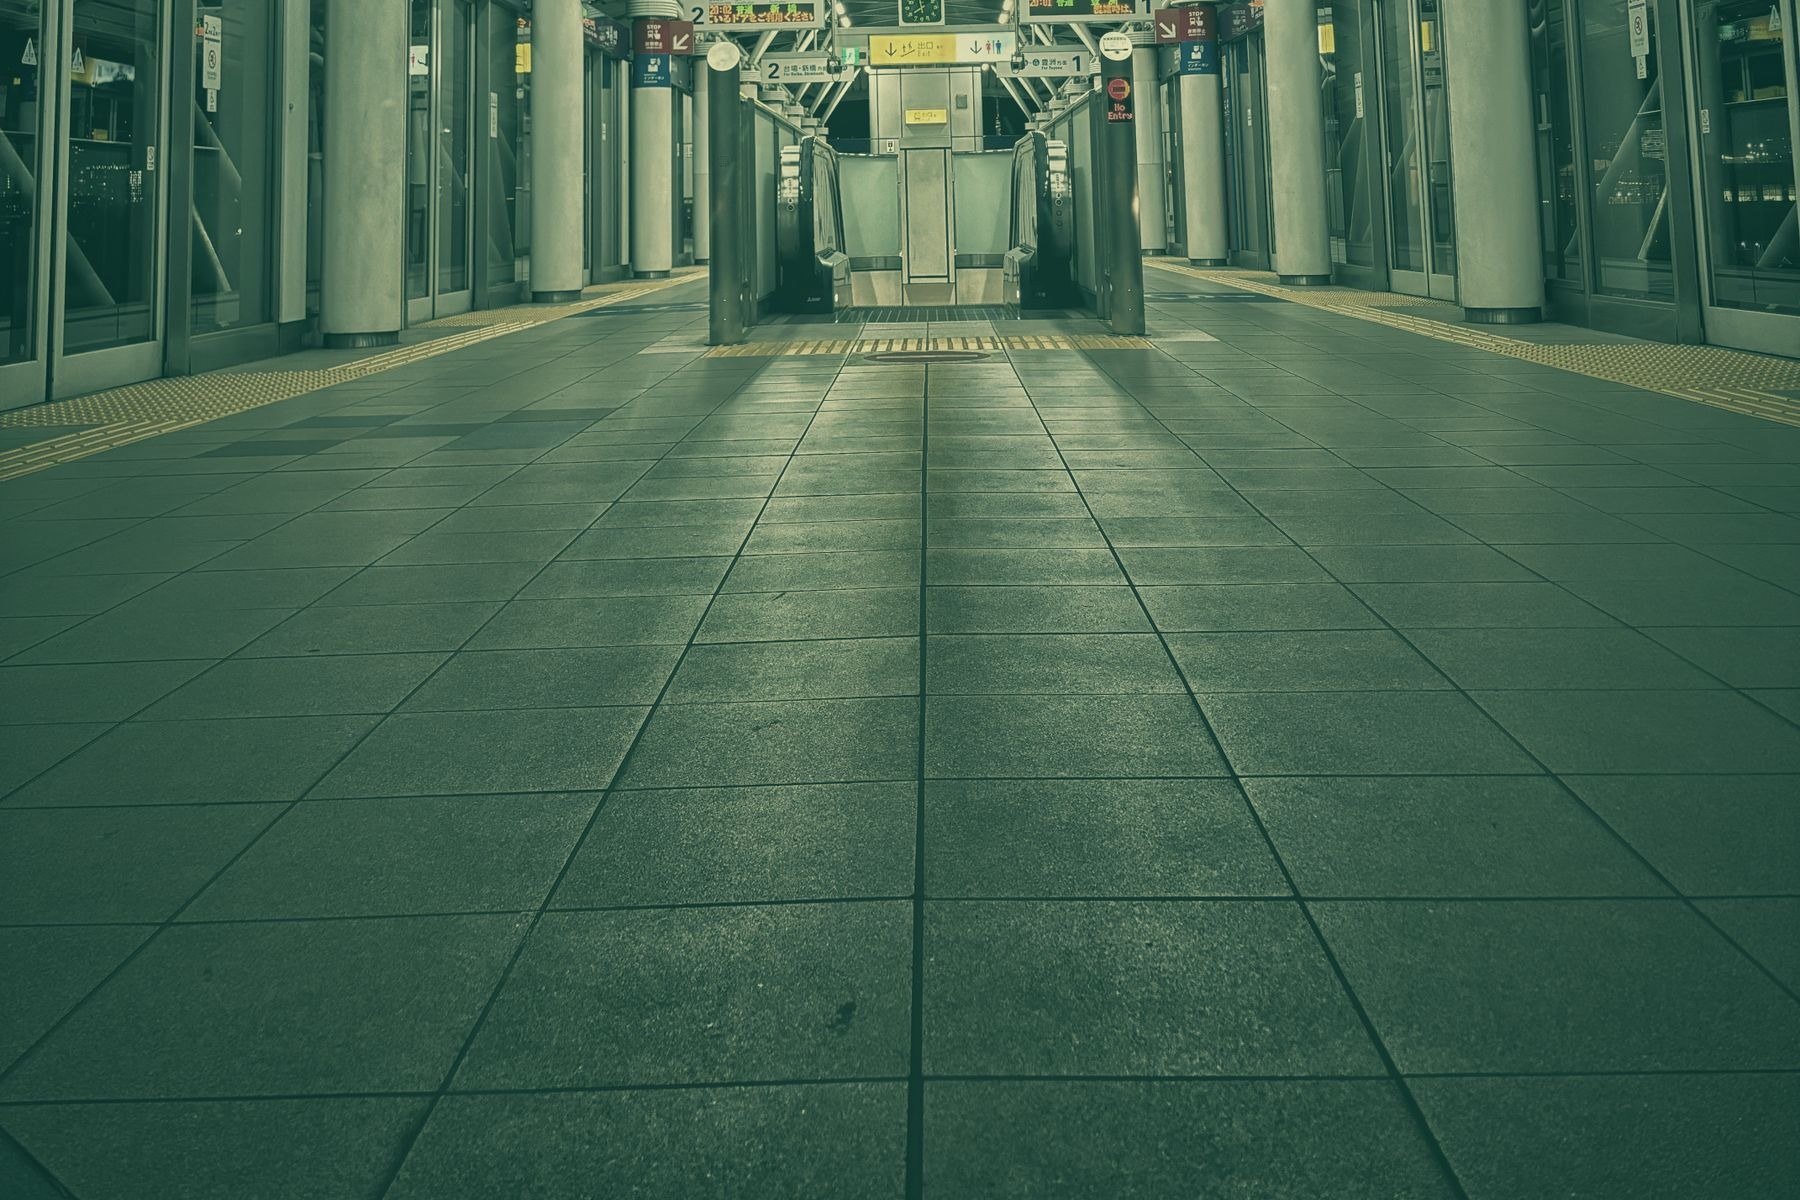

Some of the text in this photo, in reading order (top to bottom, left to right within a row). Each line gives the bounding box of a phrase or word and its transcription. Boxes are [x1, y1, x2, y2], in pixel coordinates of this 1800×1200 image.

[709, 4, 732, 15] 20:02
[691, 7, 704, 25] 2
[917, 41, 934, 50] 出口
[1072, 55, 1081, 72] 1
[768, 62, 780, 79] 2
[1113, 103, 1126, 112] No
[1107, 111, 1133, 120] Entry
